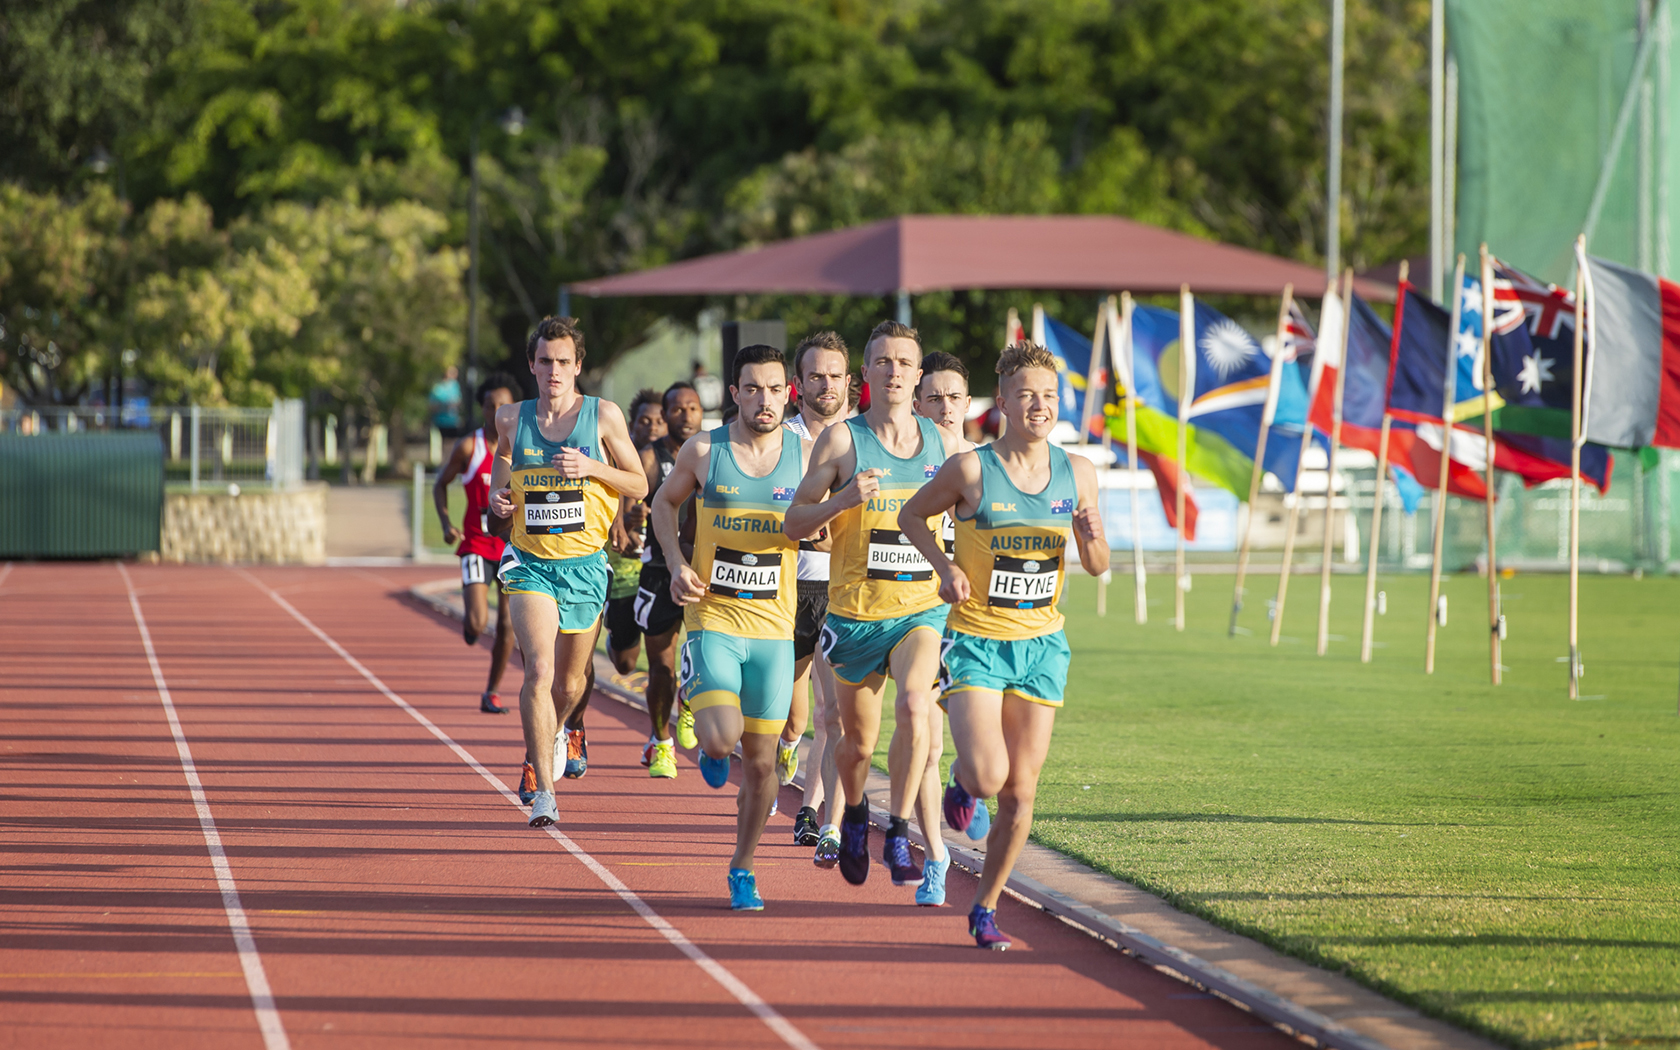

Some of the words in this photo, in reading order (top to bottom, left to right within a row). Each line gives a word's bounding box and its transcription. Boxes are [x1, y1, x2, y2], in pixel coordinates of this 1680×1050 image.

[524, 448, 544, 457] BLK
[716, 485, 739, 494] BLK
[866, 499, 909, 512] AUST
[992, 503, 1017, 512] BLK
[527, 507, 582, 520] RAMSDEN
[713, 515, 784, 533] AUSTRALI
[872, 551, 929, 564] BUCHANA
[716, 566, 776, 585] CANALA
[994, 575, 1054, 595] HEYNE
[638, 590, 652, 622] 7
